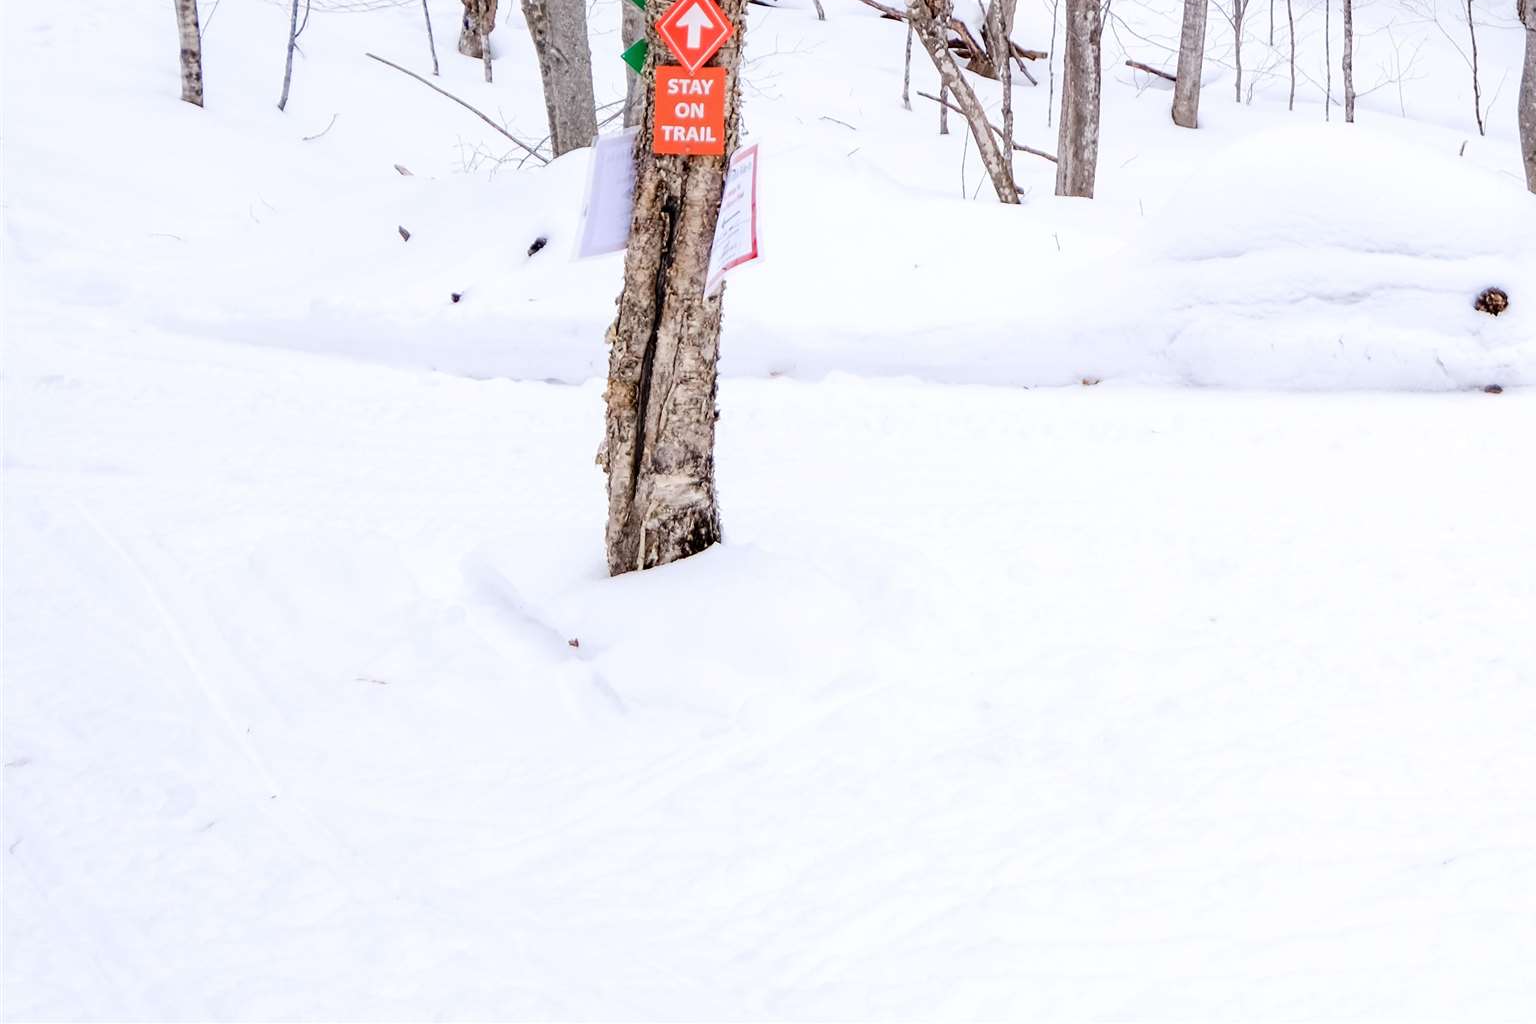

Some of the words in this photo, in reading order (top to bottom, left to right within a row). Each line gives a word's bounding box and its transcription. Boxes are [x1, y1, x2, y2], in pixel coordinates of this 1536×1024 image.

[667, 78, 714, 95] STAY
[675, 102, 705, 119] ON
[661, 125, 717, 143] TRAIL
